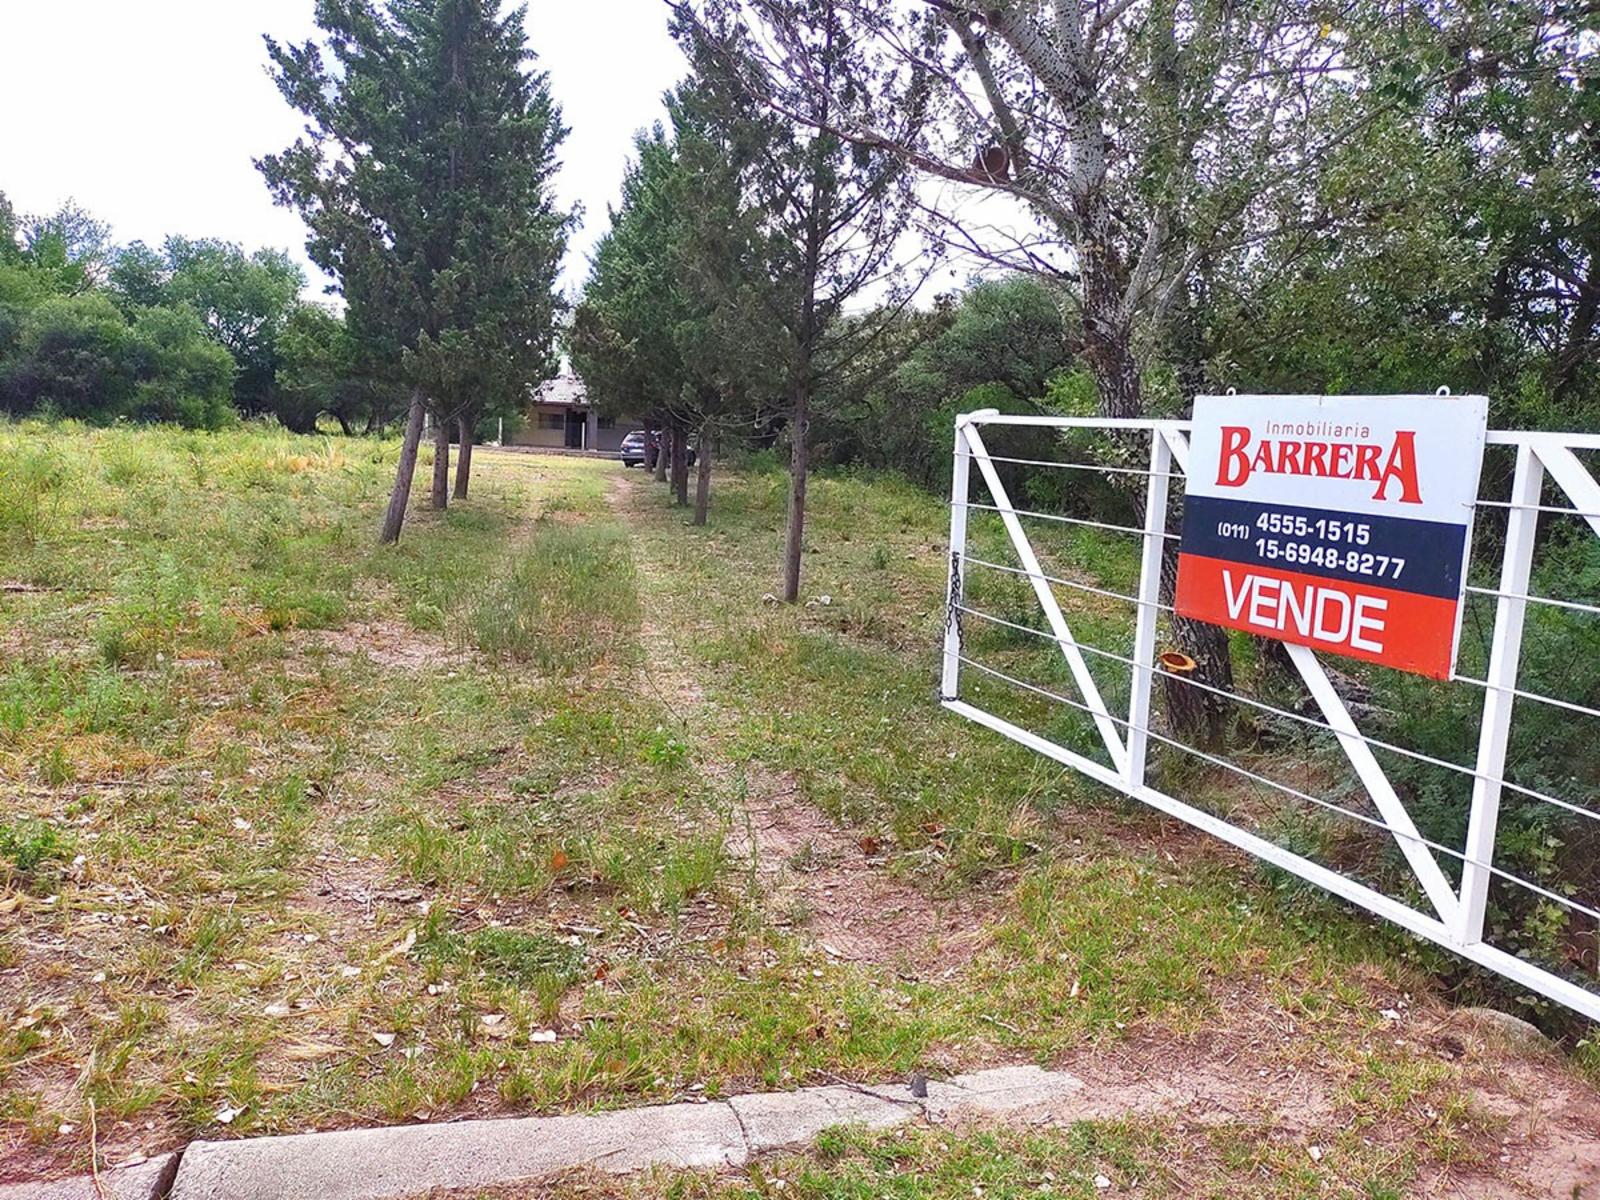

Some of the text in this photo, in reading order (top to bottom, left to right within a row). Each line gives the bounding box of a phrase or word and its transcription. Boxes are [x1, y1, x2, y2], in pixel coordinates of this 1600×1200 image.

[1266, 420, 1370, 438] Inmobiliaria
[1215, 426, 1423, 504] BARRERA
[1217, 512, 1370, 545] (011) 4555-1515
[1255, 538, 1405, 579] 15-6948-8277
[1222, 569, 1388, 654] VENDE
